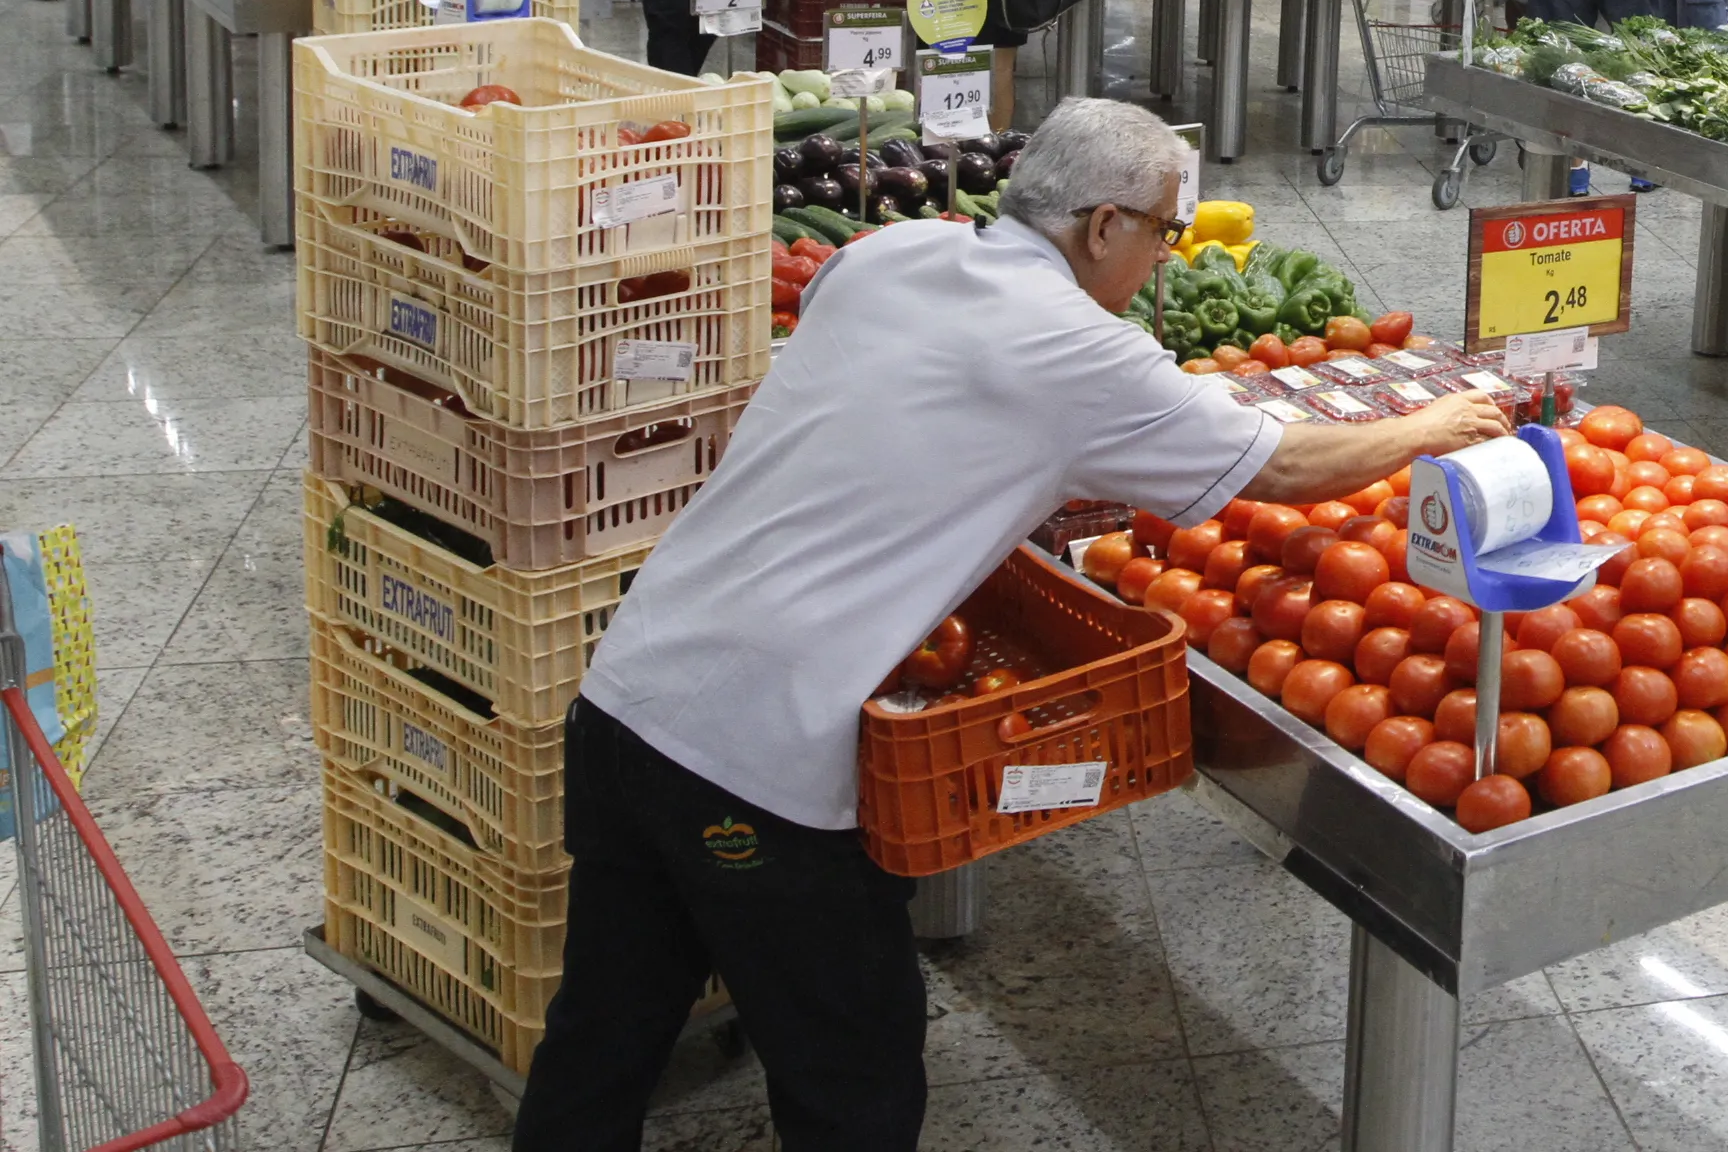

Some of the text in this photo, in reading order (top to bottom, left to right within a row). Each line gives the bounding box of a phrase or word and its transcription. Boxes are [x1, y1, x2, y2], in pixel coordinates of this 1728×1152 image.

[847, 12, 888, 20] SUPERFEIRA
[863, 47, 892, 68] 4,99
[938, 57, 976, 66] SUPERFEIRA
[1533, 217, 1606, 242] OFERTA
[1530, 248, 1572, 266] Tomate
[1546, 268, 1554, 277] Kg
[1543, 285, 1588, 325] 2,48
[1411, 531, 1457, 561] EXTRABOM
[382, 574, 455, 644] EXTRAFRUTI
